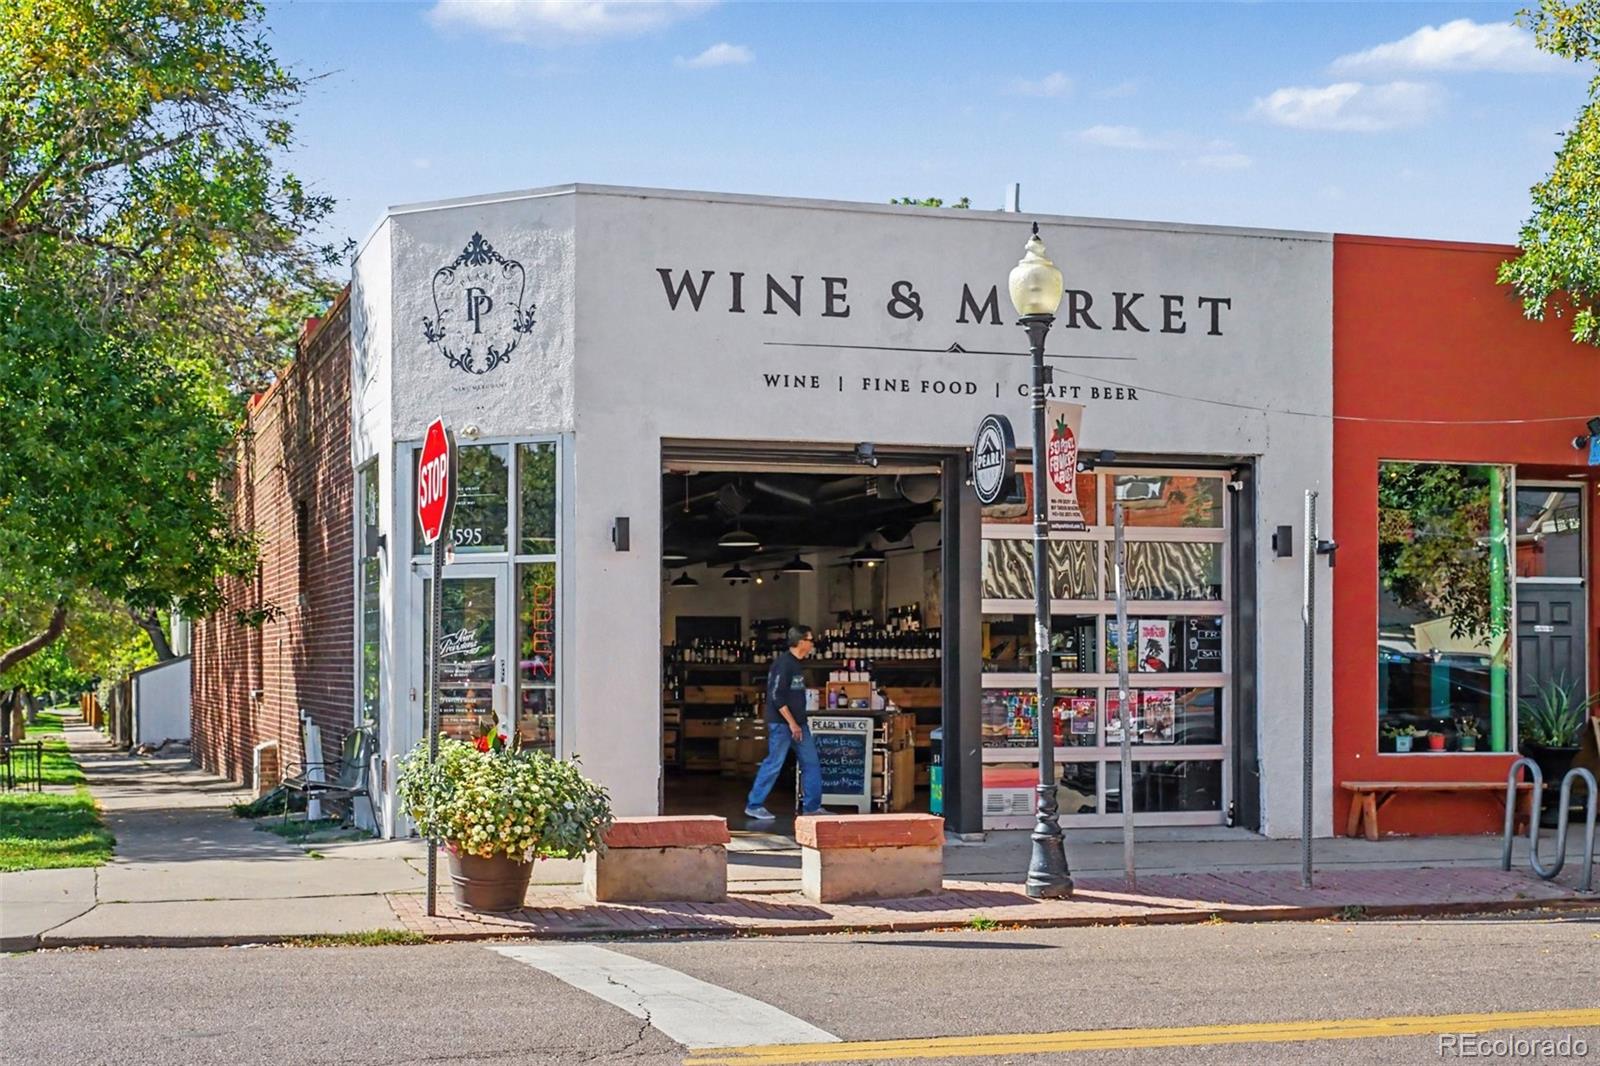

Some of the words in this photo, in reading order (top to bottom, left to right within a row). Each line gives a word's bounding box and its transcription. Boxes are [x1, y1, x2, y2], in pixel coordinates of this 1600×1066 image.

[656, 268, 850, 317] WINE
[887, 280, 924, 322] &
[956, 283, 1231, 336] MRKET
[764, 374, 820, 388] WINE
[862, 378, 910, 392] FINE
[921, 380, 977, 394] FOOD
[1018, 383, 1082, 398] CAFT
[1092, 387, 1139, 401] BEER
[978, 451, 1000, 469] PEARL
[421, 453, 447, 509] STOP
[533, 584, 553, 676] OPEN
[812, 720, 836, 729] PEARL
